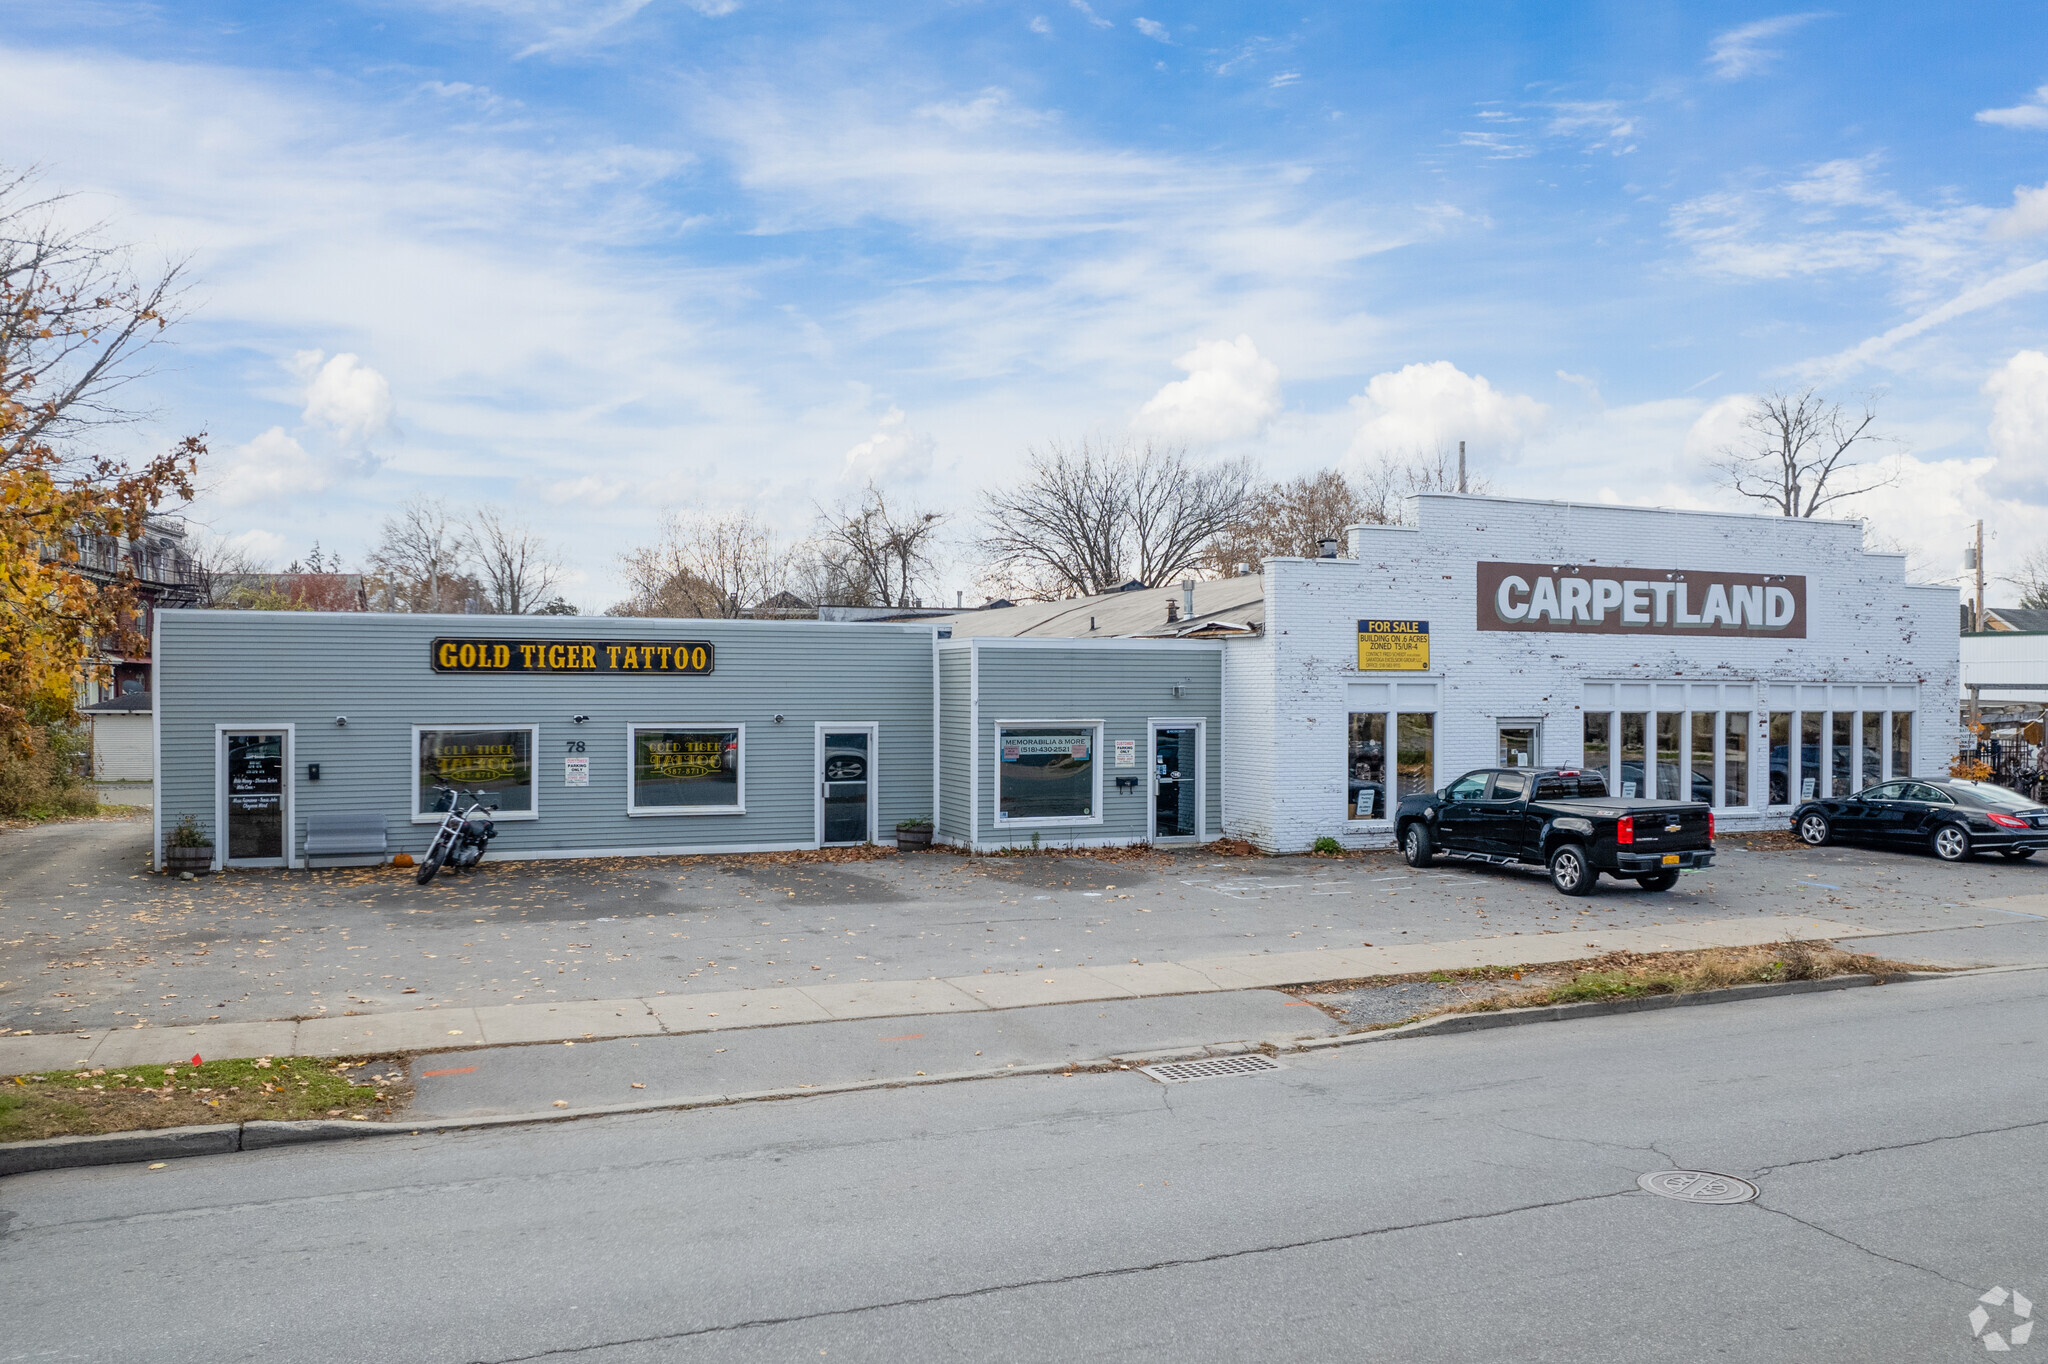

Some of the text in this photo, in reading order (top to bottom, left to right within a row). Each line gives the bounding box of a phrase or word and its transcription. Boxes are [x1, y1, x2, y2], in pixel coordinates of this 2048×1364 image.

[1496, 575, 1796, 629] CARPETLAND
[1368, 621, 1419, 633] FOR SALE
[1409, 635, 1428, 643] ACRES
[439, 643, 707, 670] GOLD TIGER TATTOO
[566, 741, 585, 753] 78
[685, 742, 721, 751] TIGER
